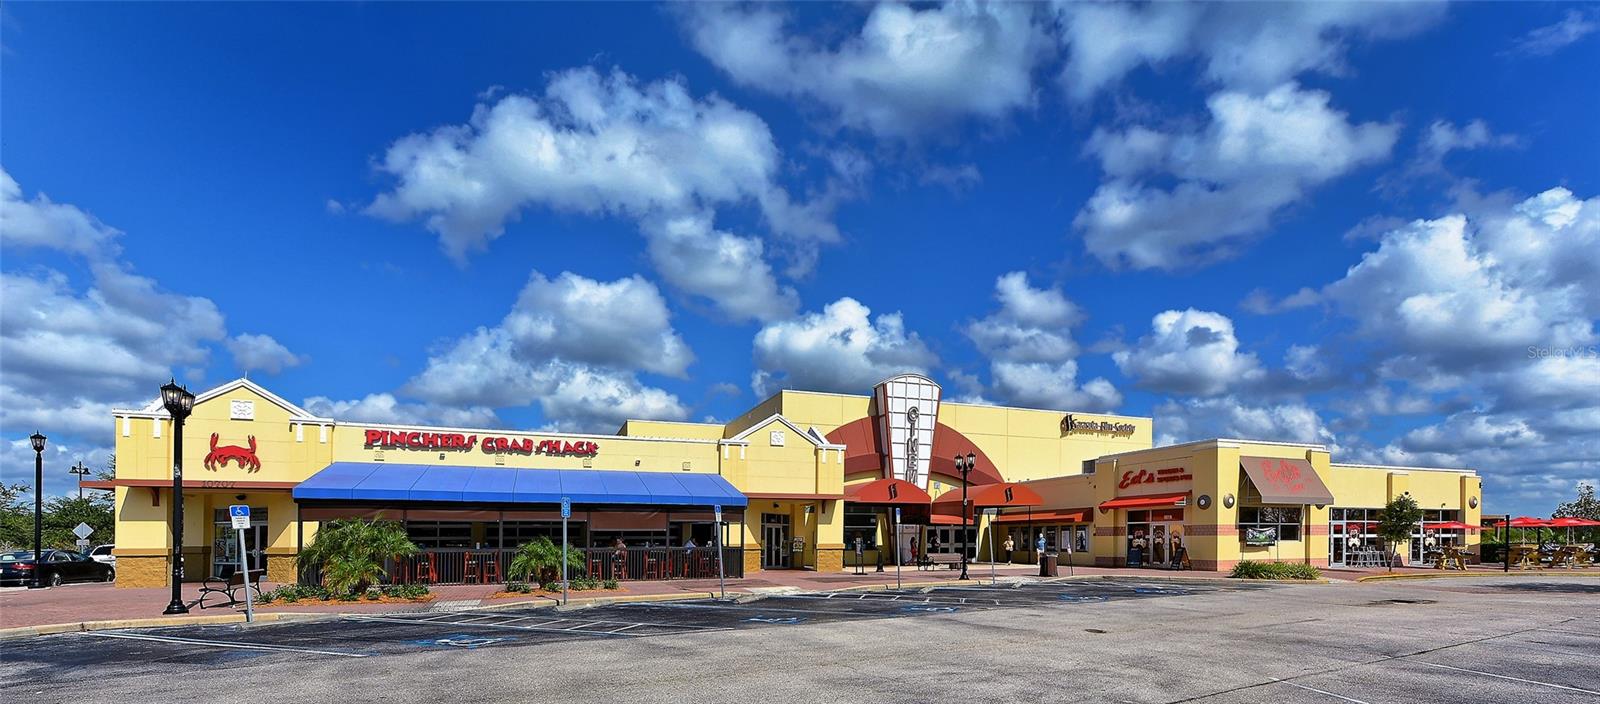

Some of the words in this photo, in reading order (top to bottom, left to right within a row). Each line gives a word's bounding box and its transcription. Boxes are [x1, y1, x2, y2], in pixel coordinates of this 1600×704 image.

[481, 437, 534, 454] CRAB
[535, 440, 600, 457] SHACK
[1119, 469, 1155, 489] Ed's
